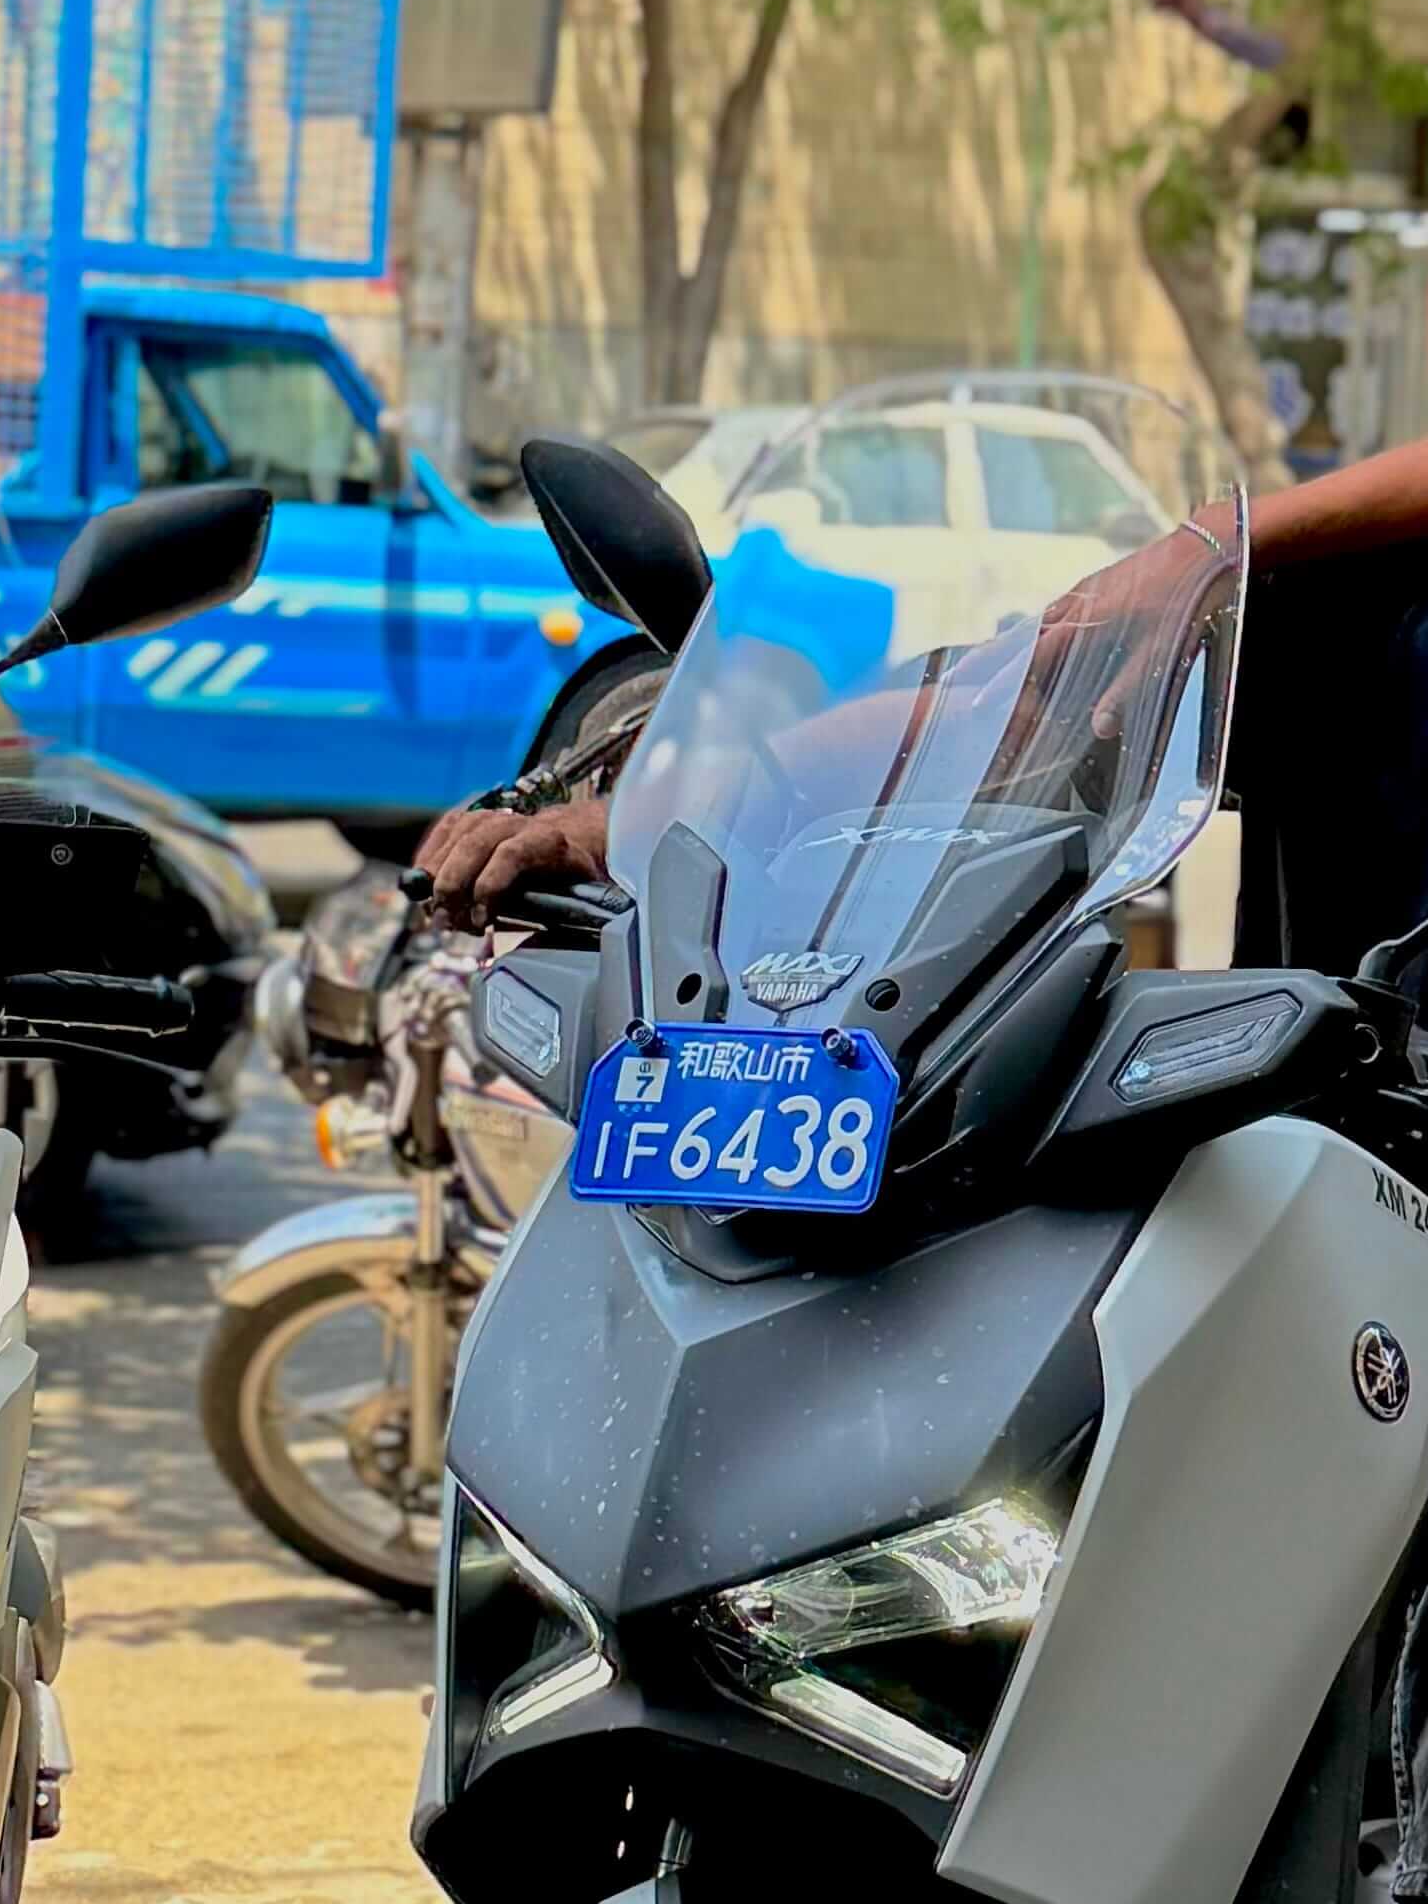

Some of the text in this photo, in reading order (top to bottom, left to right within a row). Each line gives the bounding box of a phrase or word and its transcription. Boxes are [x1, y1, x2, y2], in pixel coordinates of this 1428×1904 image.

[756, 983, 820, 1001] YAMAHA
[677, 1040, 815, 1084] 和歌山市
[636, 1076, 655, 1098] 7
